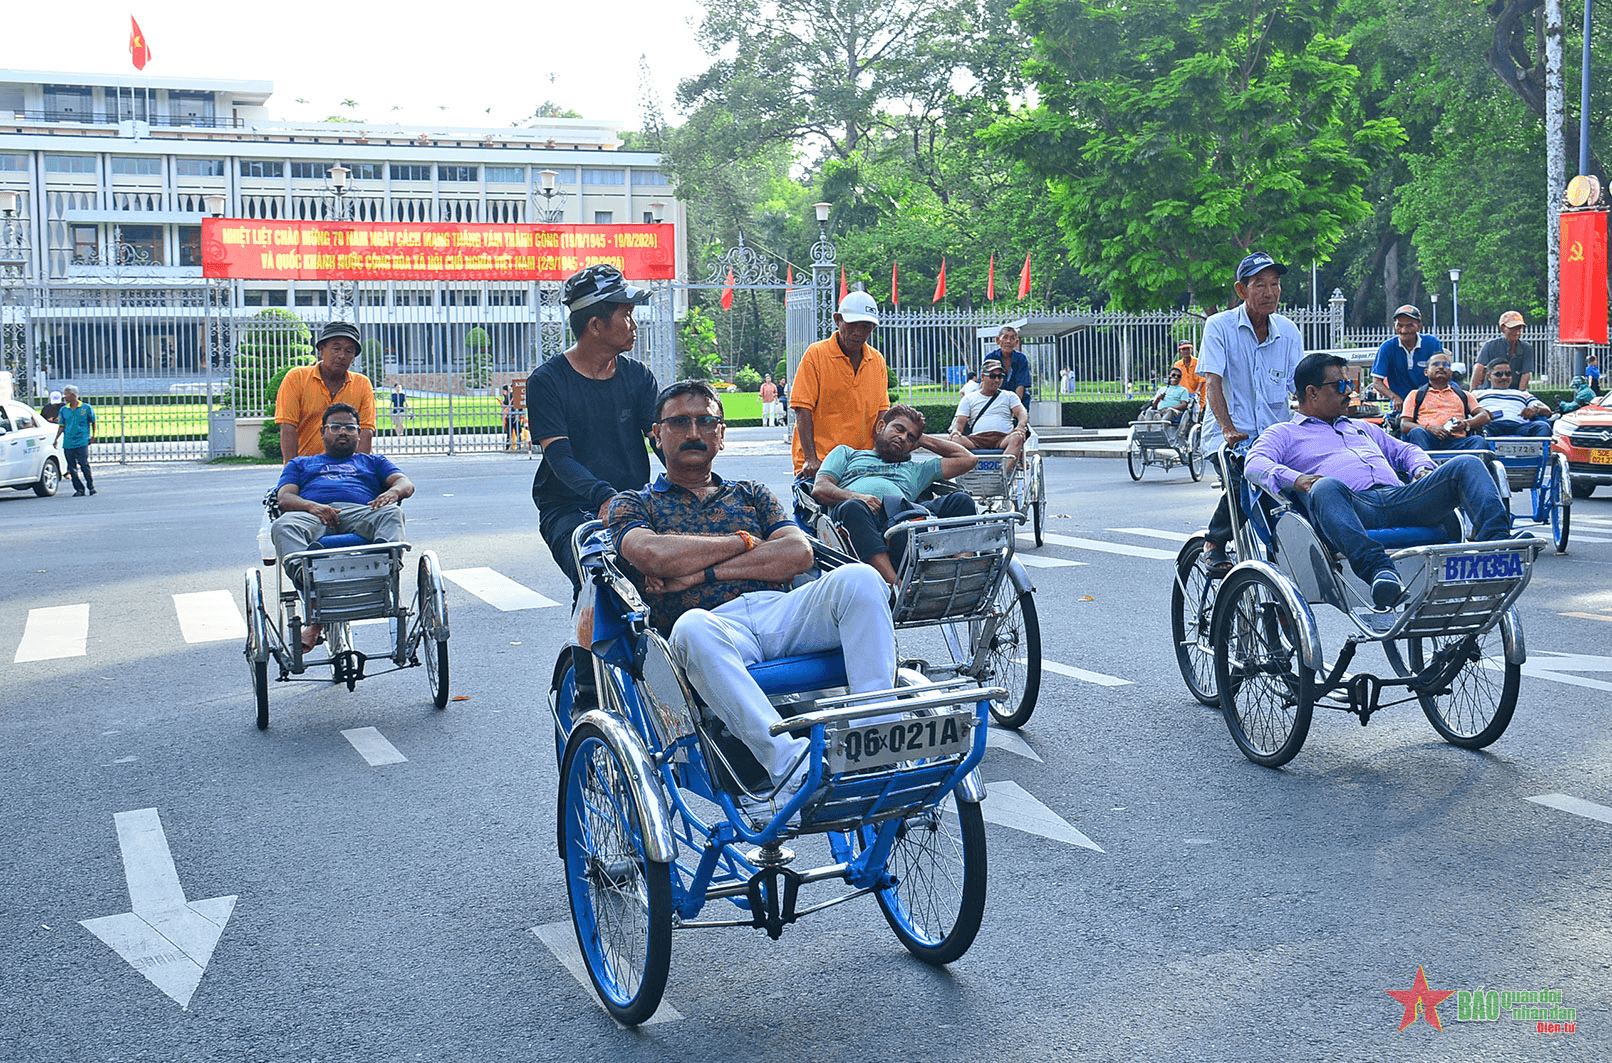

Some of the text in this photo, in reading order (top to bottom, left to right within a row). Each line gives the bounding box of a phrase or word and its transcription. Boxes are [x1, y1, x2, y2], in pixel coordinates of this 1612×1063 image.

[222, 225, 251, 248] NHIỆT
[252, 226, 272, 248] LIỆT
[274, 226, 300, 246] CHÀO
[346, 227, 368, 246] NĂM
[370, 228, 394, 247] NGÀY
[396, 228, 422, 247] CÁCH
[423, 231, 450, 250] MẠNG
[452, 229, 482, 248] THÁNG
[482, 229, 502, 248] TÁM
[504, 229, 533, 248] THÀNH
[535, 230, 559, 248] CÔNG
[613, 233, 658, 249] 19/8/2024)
[261, 250, 274, 269] VÀ
[276, 248, 302, 271] QUỐC
[303, 251, 336, 270] KHÁNH
[365, 252, 392, 274] CỘNG
[494, 252, 513, 274] VIỆT
[514, 256, 536, 270] NAM
[538, 256, 578, 272] (2/9/1945
[1445, 552, 1523, 580] BTX135A
